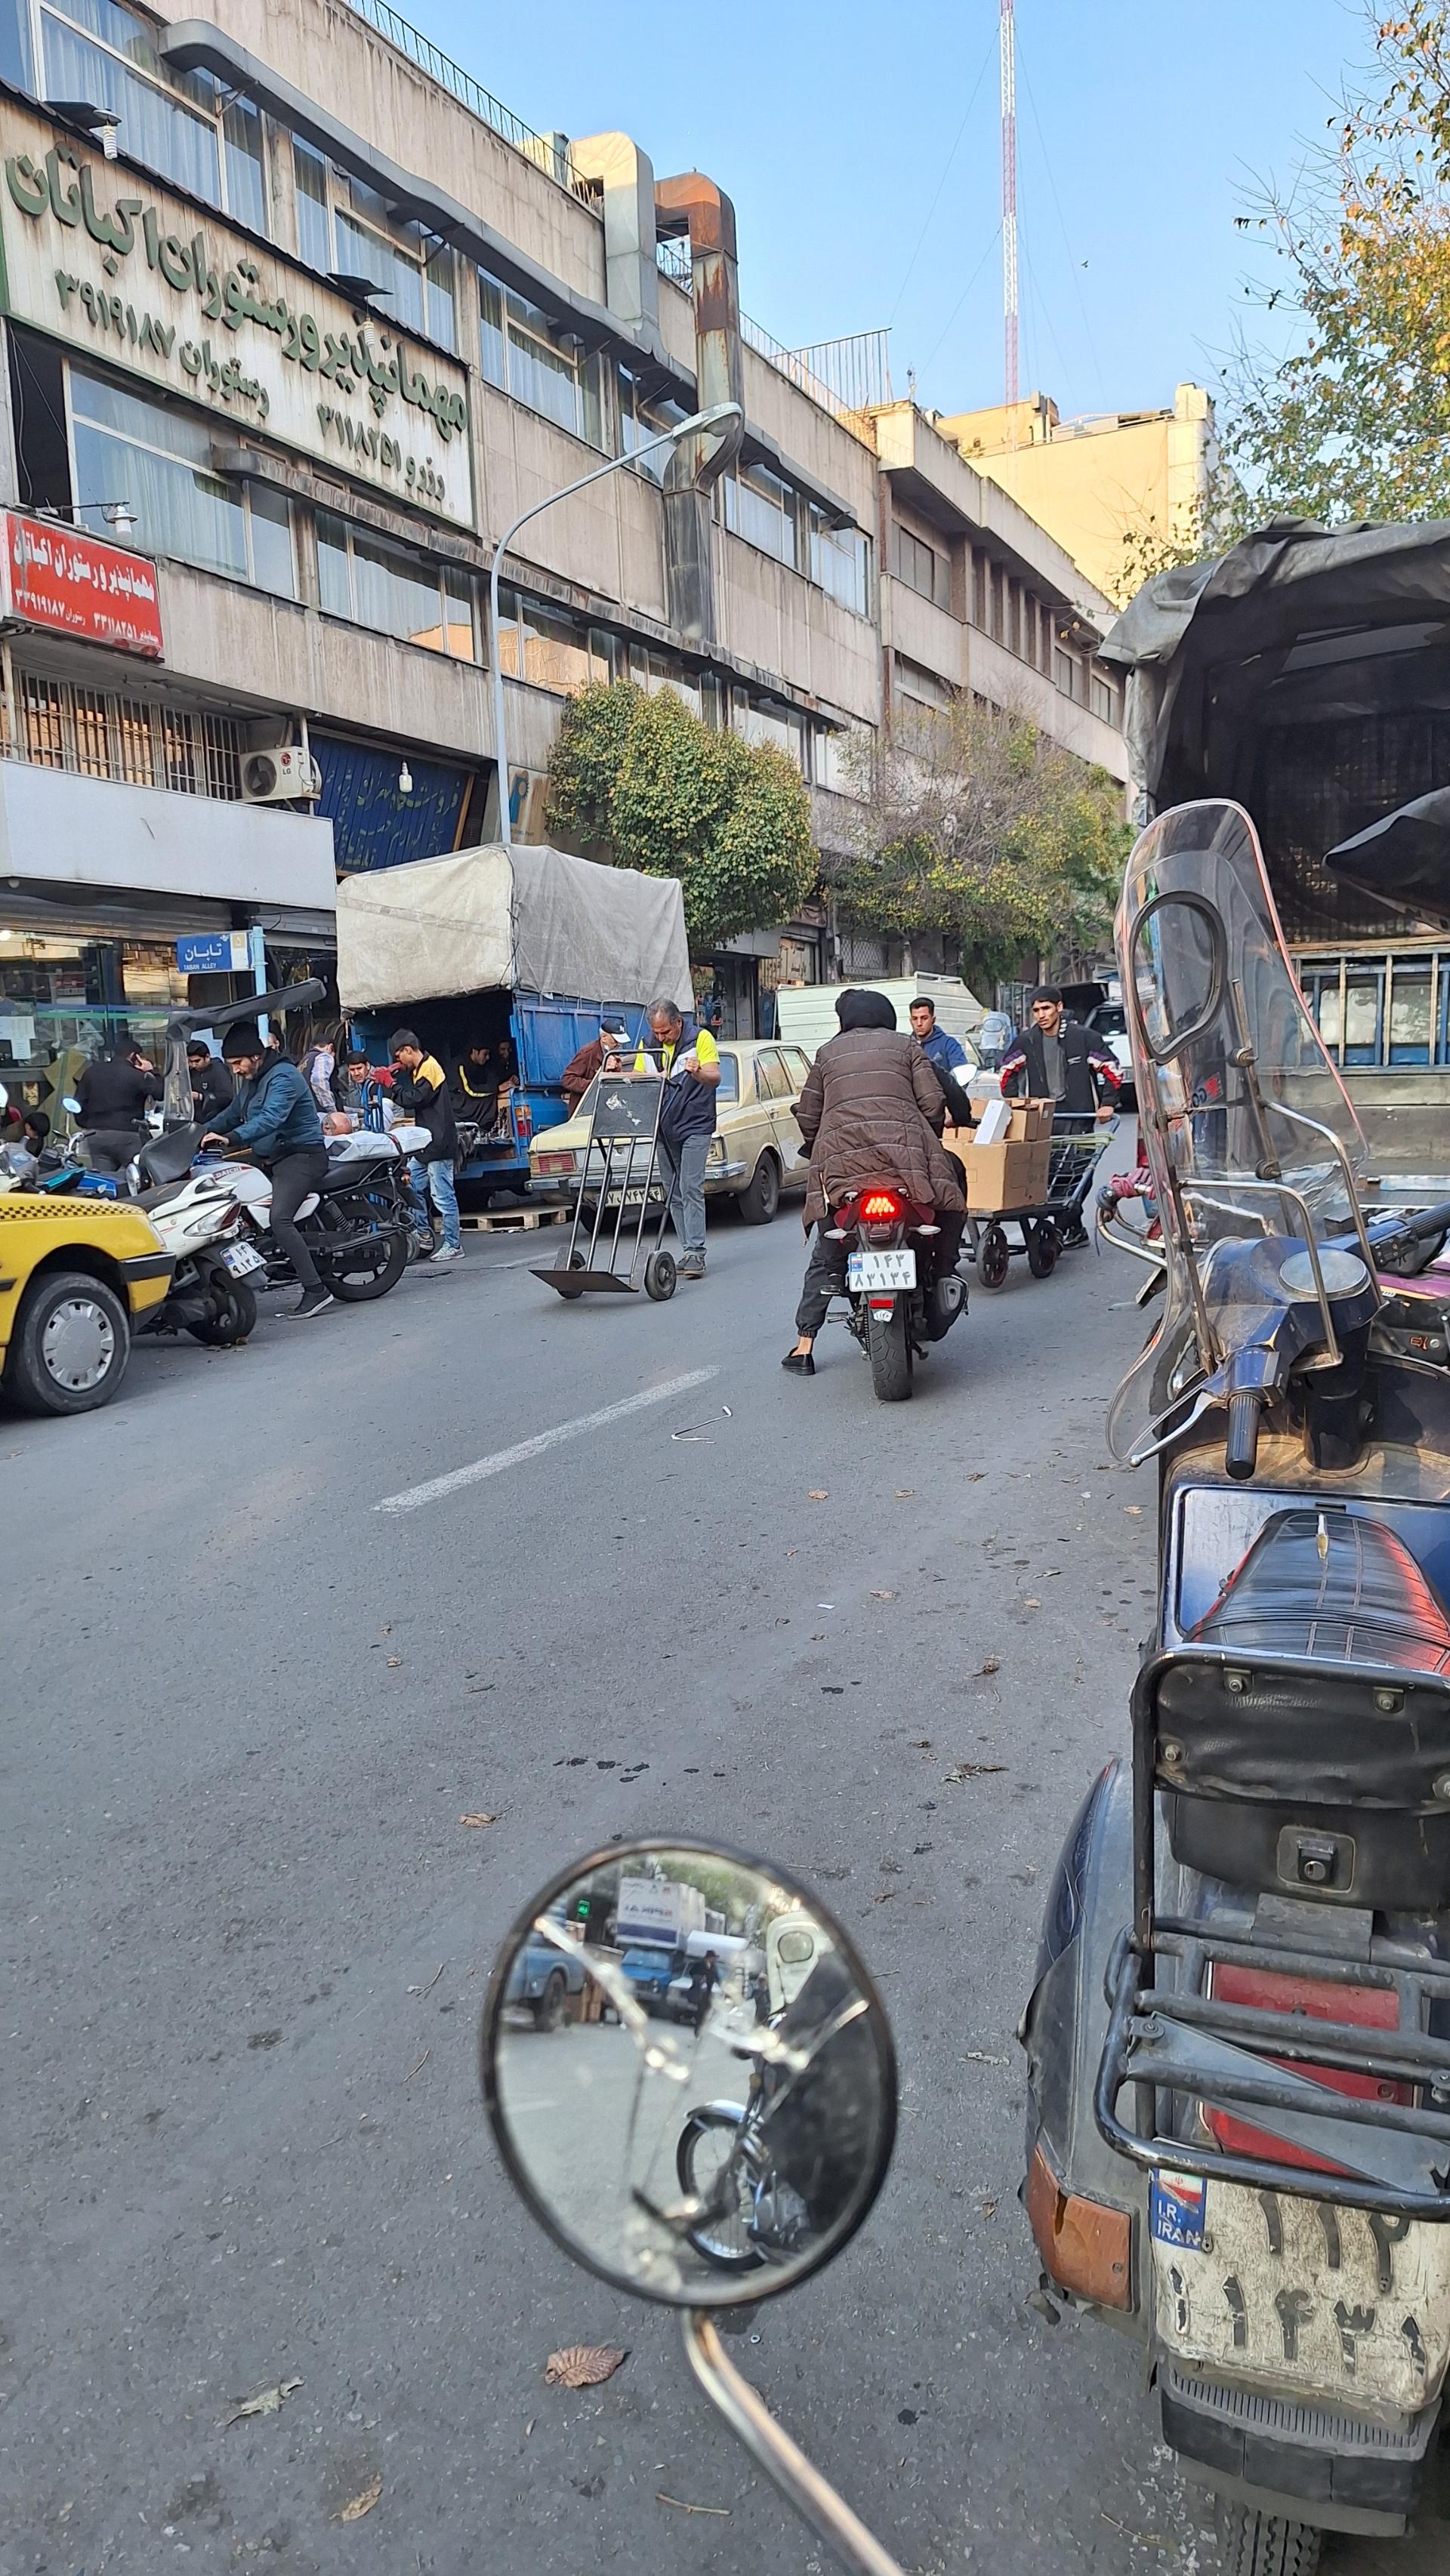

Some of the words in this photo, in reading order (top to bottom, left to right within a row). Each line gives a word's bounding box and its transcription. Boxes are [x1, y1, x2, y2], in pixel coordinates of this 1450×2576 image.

[5, 141, 158, 277] اکباتان
[159, 231, 301, 361] رستوران
[300, 313, 320, 372] و
[180, 339, 270, 418] رستوران
[184, 942, 222, 962] تابان
[873, 1254, 905, 1268] ۱۴۳
[855, 1271, 911, 1286] ۸۳۱۳۴
[1158, 2199, 1181, 2223] I.R.
[1157, 2220, 1202, 2247] IRAN
